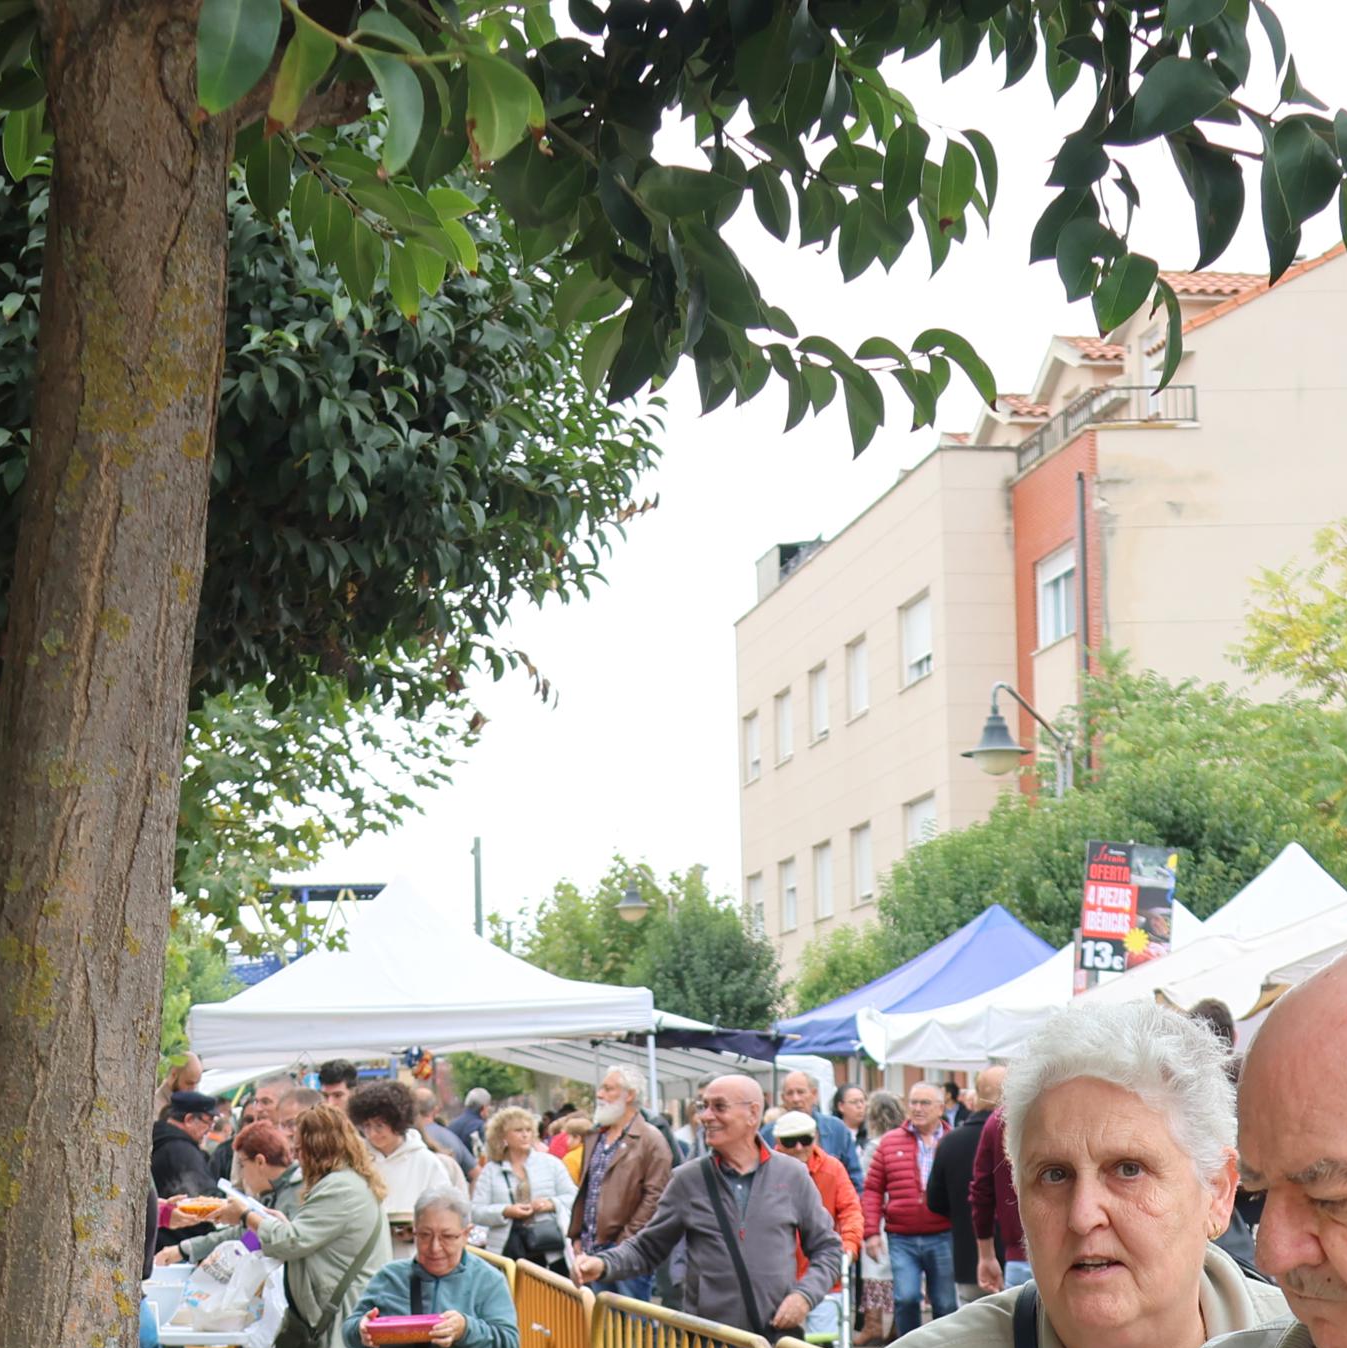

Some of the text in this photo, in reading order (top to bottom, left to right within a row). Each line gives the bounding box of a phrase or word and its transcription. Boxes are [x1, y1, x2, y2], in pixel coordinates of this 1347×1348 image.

[1089, 863, 1131, 882] OFERTA
[1086, 885, 1132, 909] 4 PIEZAS
